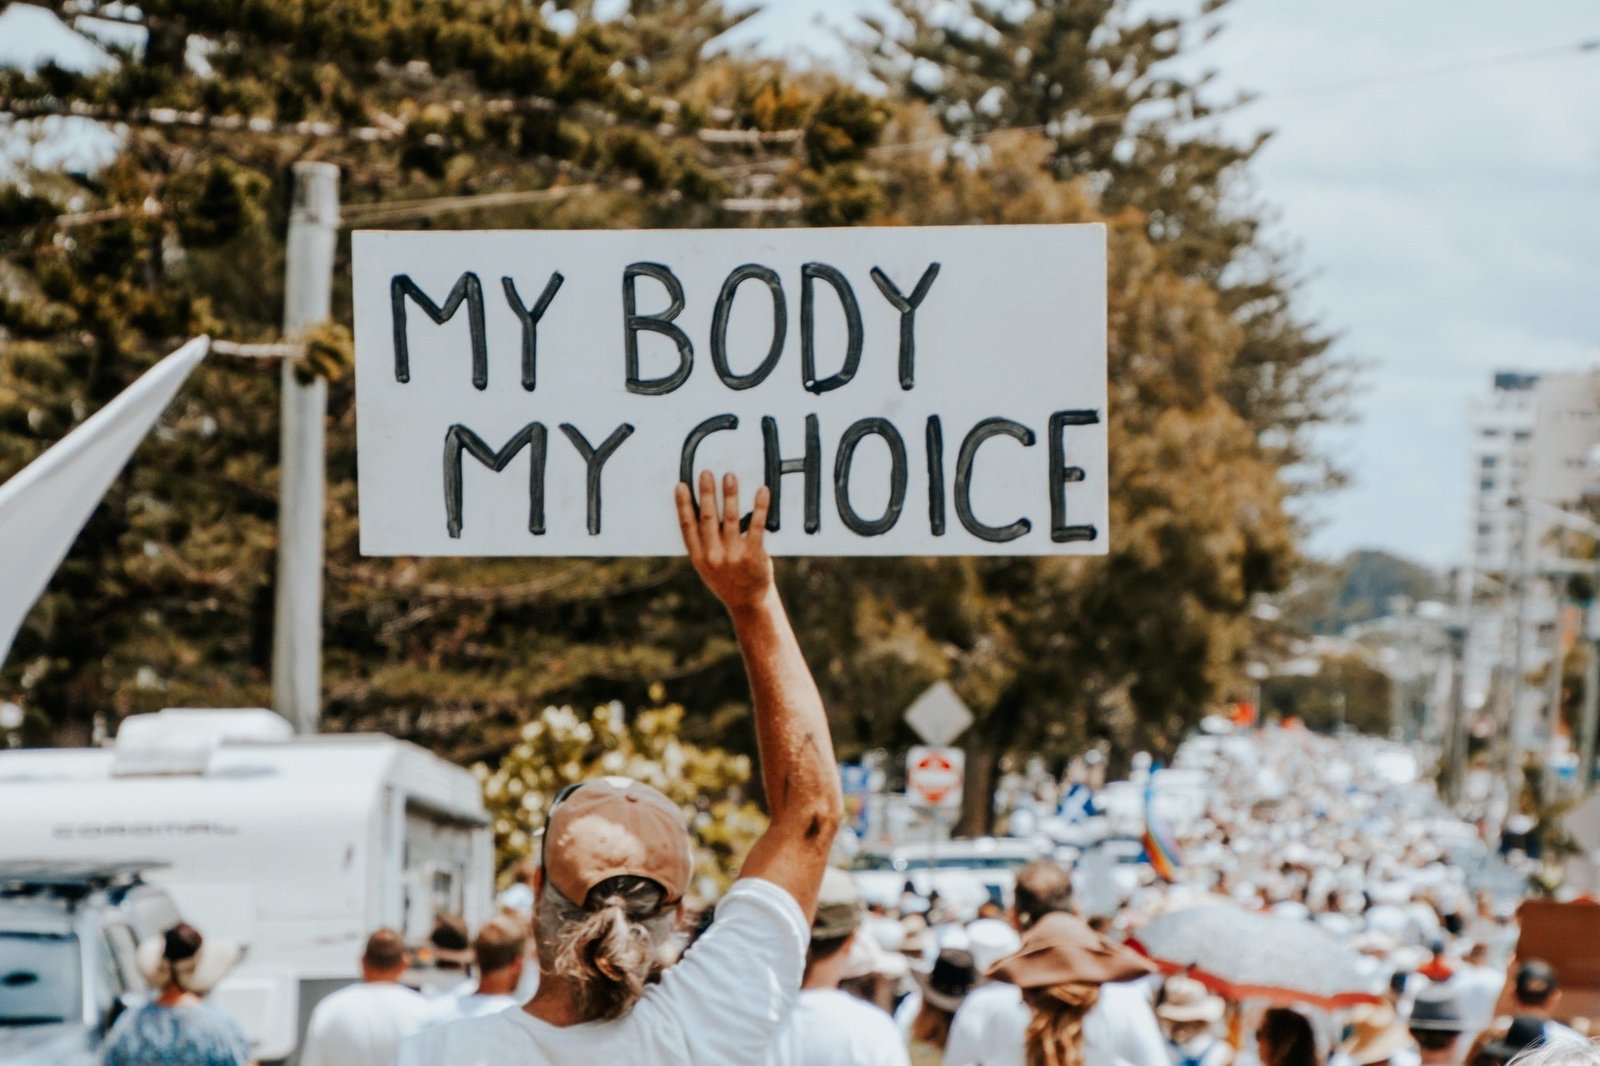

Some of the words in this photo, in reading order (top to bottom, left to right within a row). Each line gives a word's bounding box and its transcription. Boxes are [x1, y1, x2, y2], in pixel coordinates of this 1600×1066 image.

[391, 271, 564, 392] MY
[623, 261, 941, 396] BODY
[443, 422, 635, 538] MY
[679, 408, 1100, 543] CHOICE
